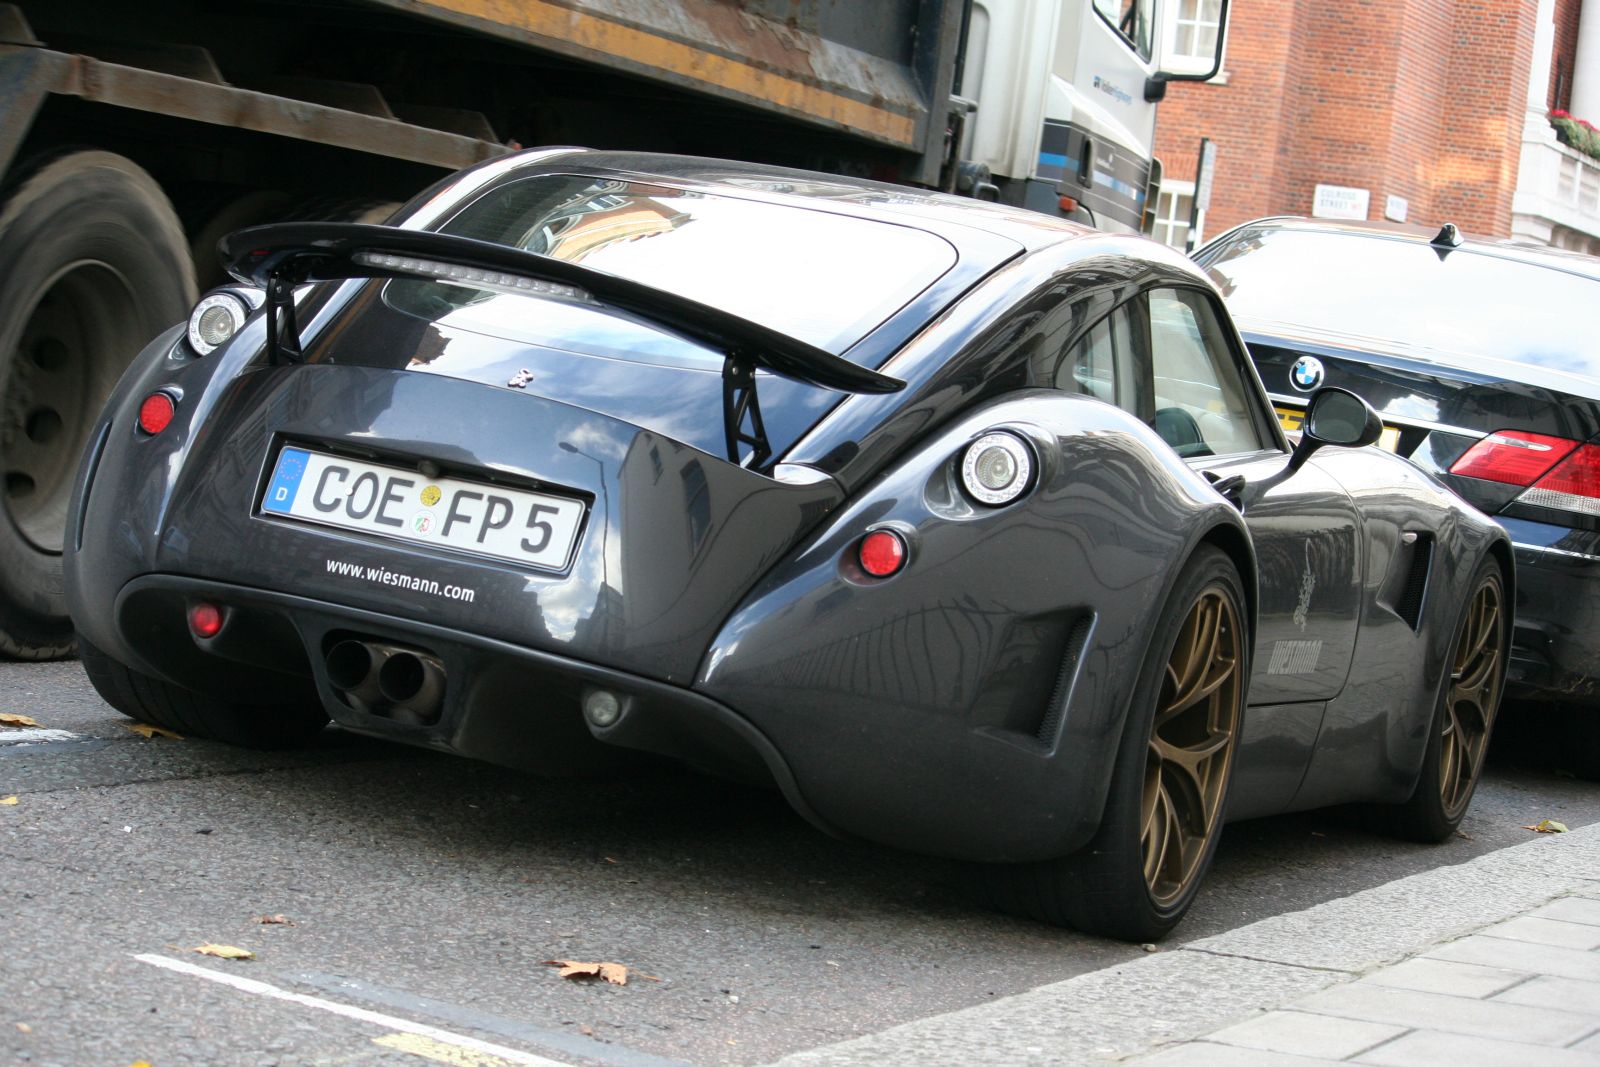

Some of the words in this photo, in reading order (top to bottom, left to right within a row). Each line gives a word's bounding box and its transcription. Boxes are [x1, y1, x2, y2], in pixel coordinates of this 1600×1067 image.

[275, 487, 288, 502] D
[312, 465, 415, 528] COE
[440, 489, 514, 544] FP
[520, 503, 560, 554] 5
[326, 558, 475, 603] www.wiesmann.com
